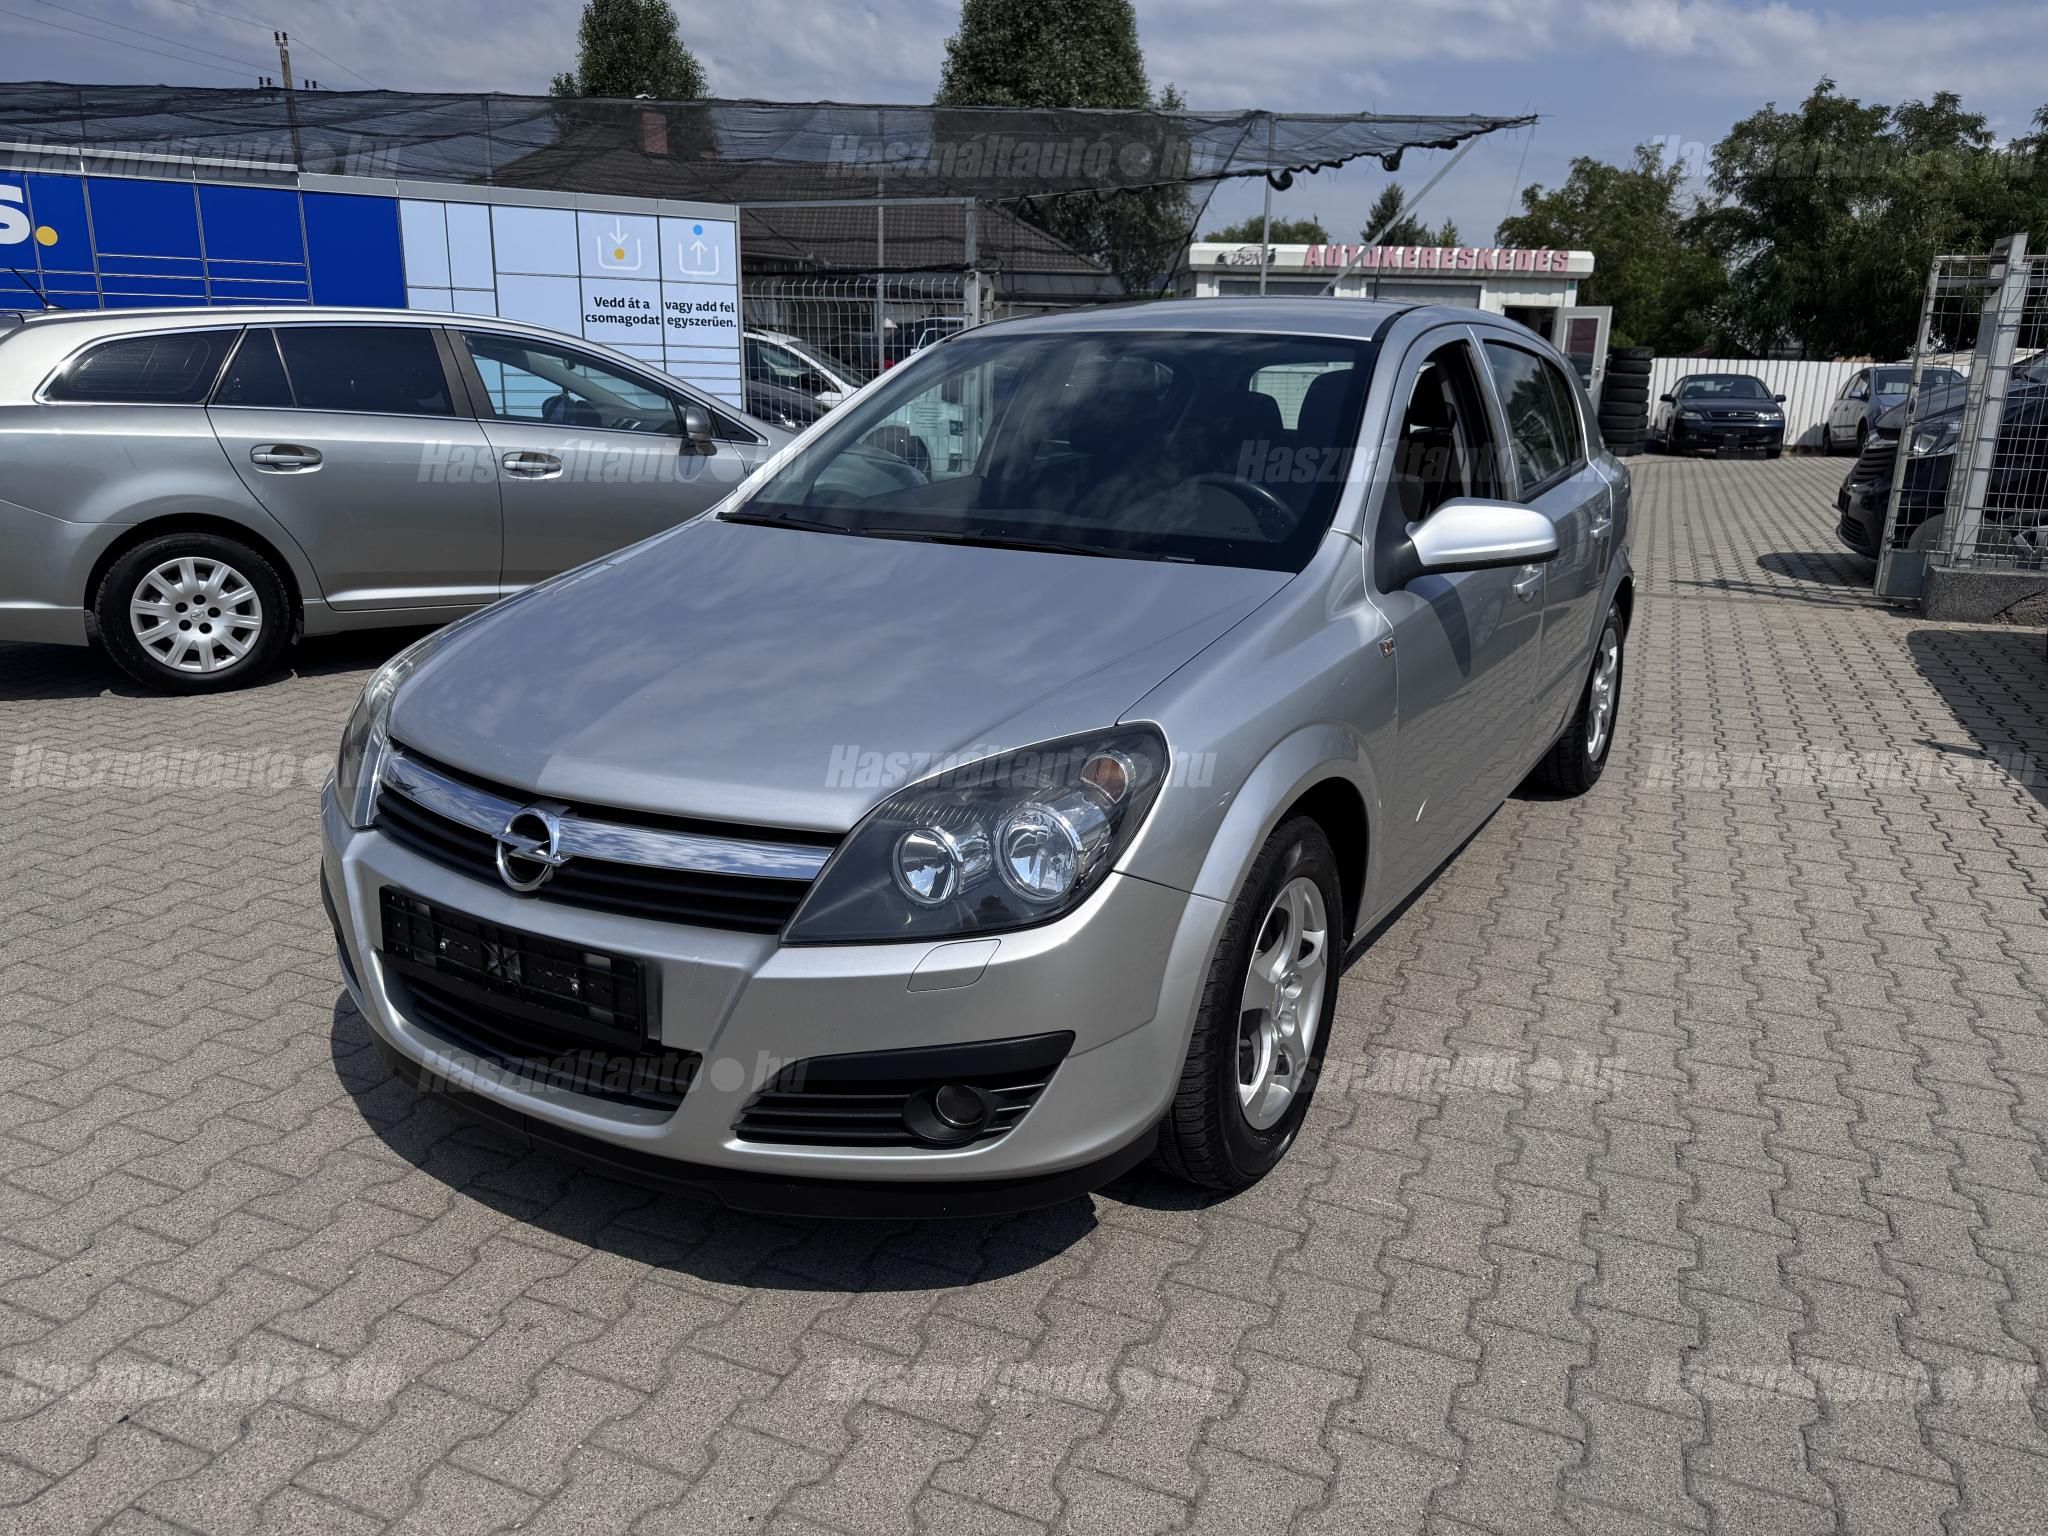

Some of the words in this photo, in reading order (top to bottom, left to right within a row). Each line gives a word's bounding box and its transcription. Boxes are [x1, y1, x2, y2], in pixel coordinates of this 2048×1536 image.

[593, 296, 625, 309] Vedd
[628, 297, 640, 309] át
[643, 300, 650, 309] a
[665, 301, 693, 314] vagy
[695, 301, 717, 312] add
[719, 301, 735, 313] fel
[585, 313, 660, 327] csomagodat
[667, 316, 737, 329] egyszerűen.
